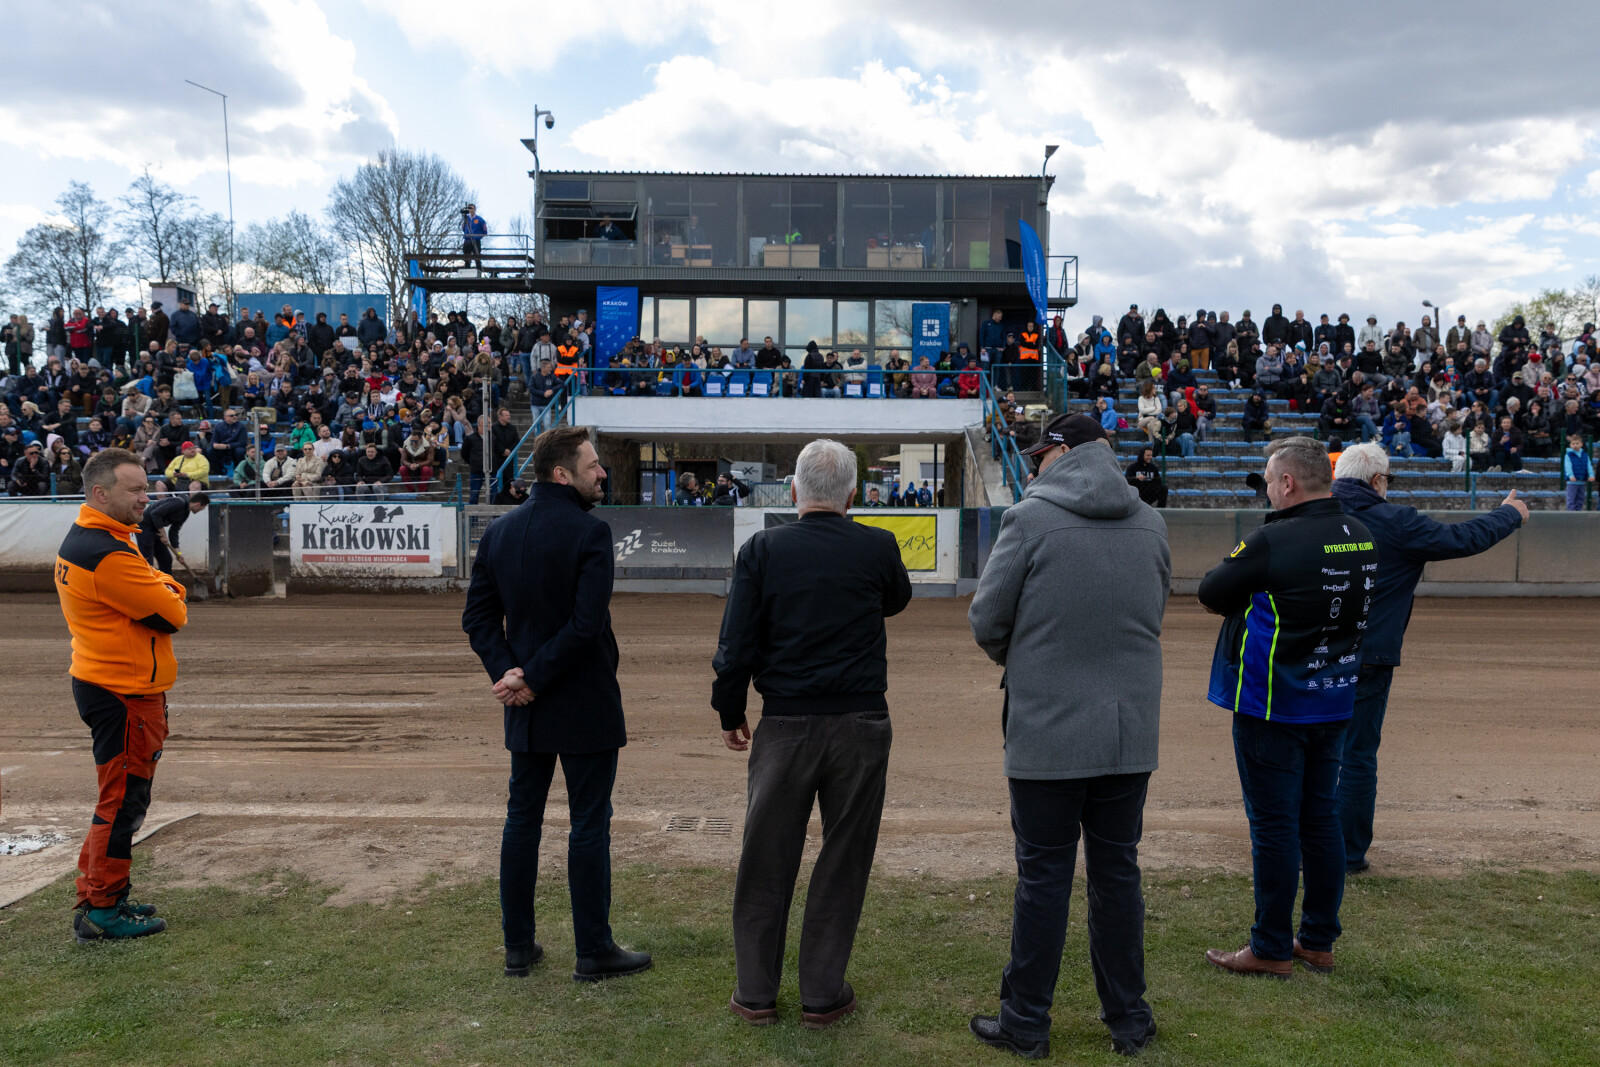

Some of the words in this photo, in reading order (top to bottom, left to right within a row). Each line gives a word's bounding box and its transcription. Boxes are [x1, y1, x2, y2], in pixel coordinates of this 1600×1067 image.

[318, 504, 364, 526] Kurier
[302, 524, 430, 550] Krakowski
[1324, 543, 1358, 554] DYREKTOR
